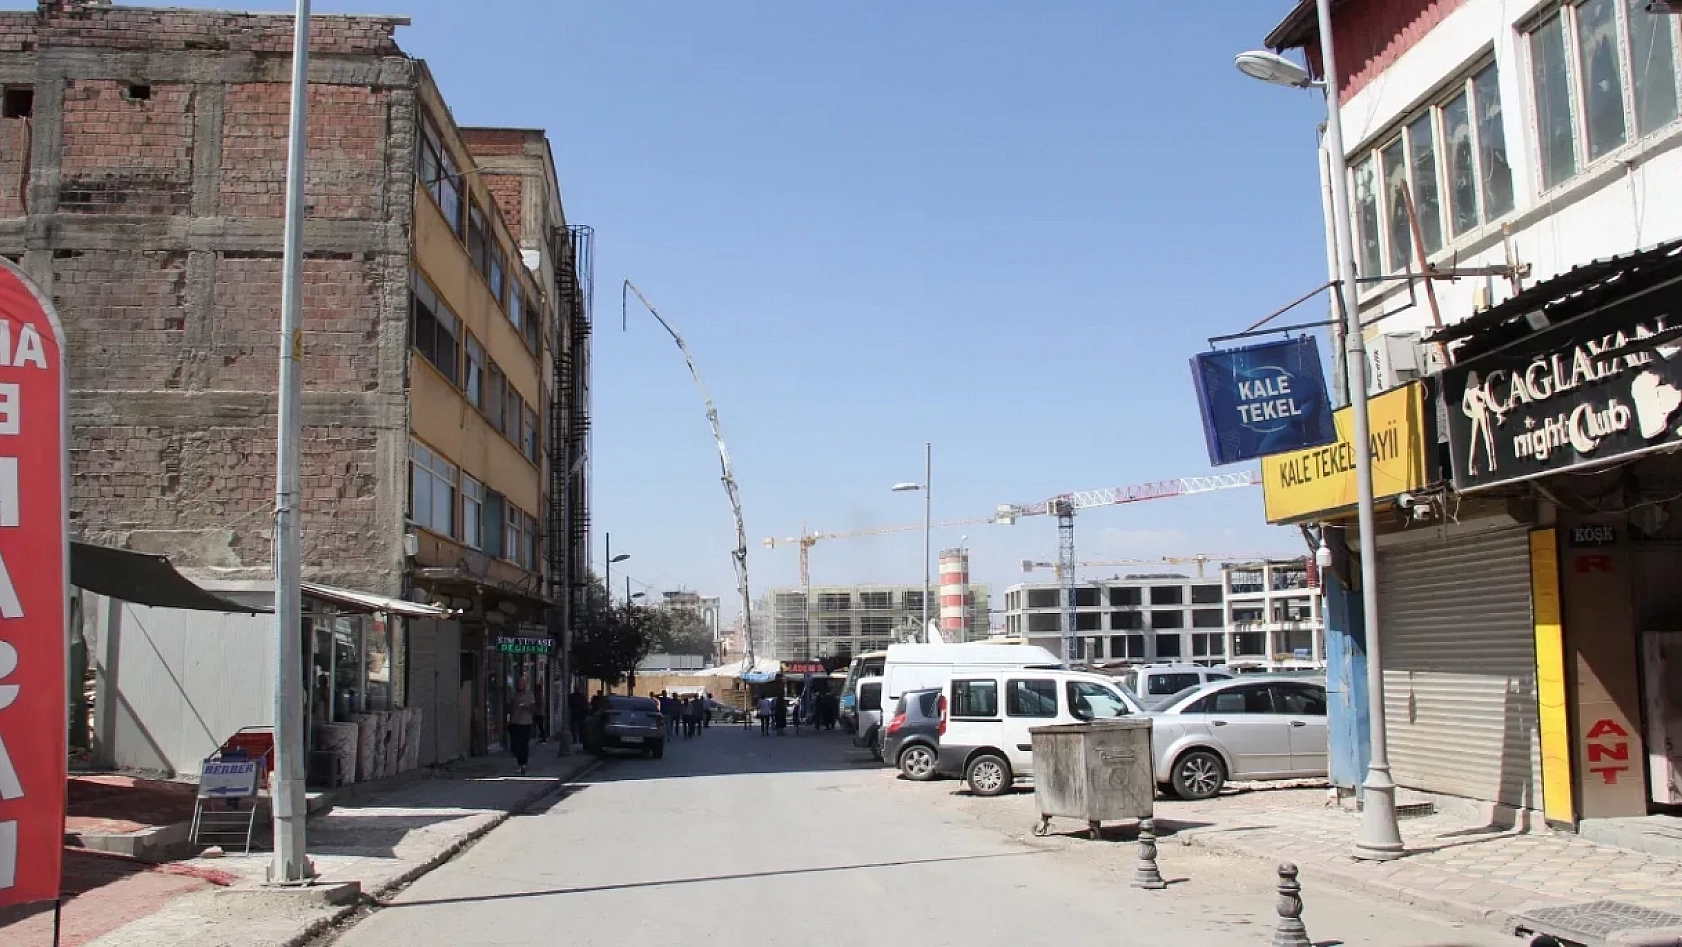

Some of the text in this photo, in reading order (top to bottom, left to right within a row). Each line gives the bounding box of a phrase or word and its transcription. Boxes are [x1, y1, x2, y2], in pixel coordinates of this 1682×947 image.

[1238, 376, 1291, 400] KALE
[1236, 399, 1302, 423] TEKEL
[1513, 399, 1631, 460] night Club
[1279, 420, 1398, 489] KALE TEKEL AYİİ
[204, 764, 254, 775] BERBER
